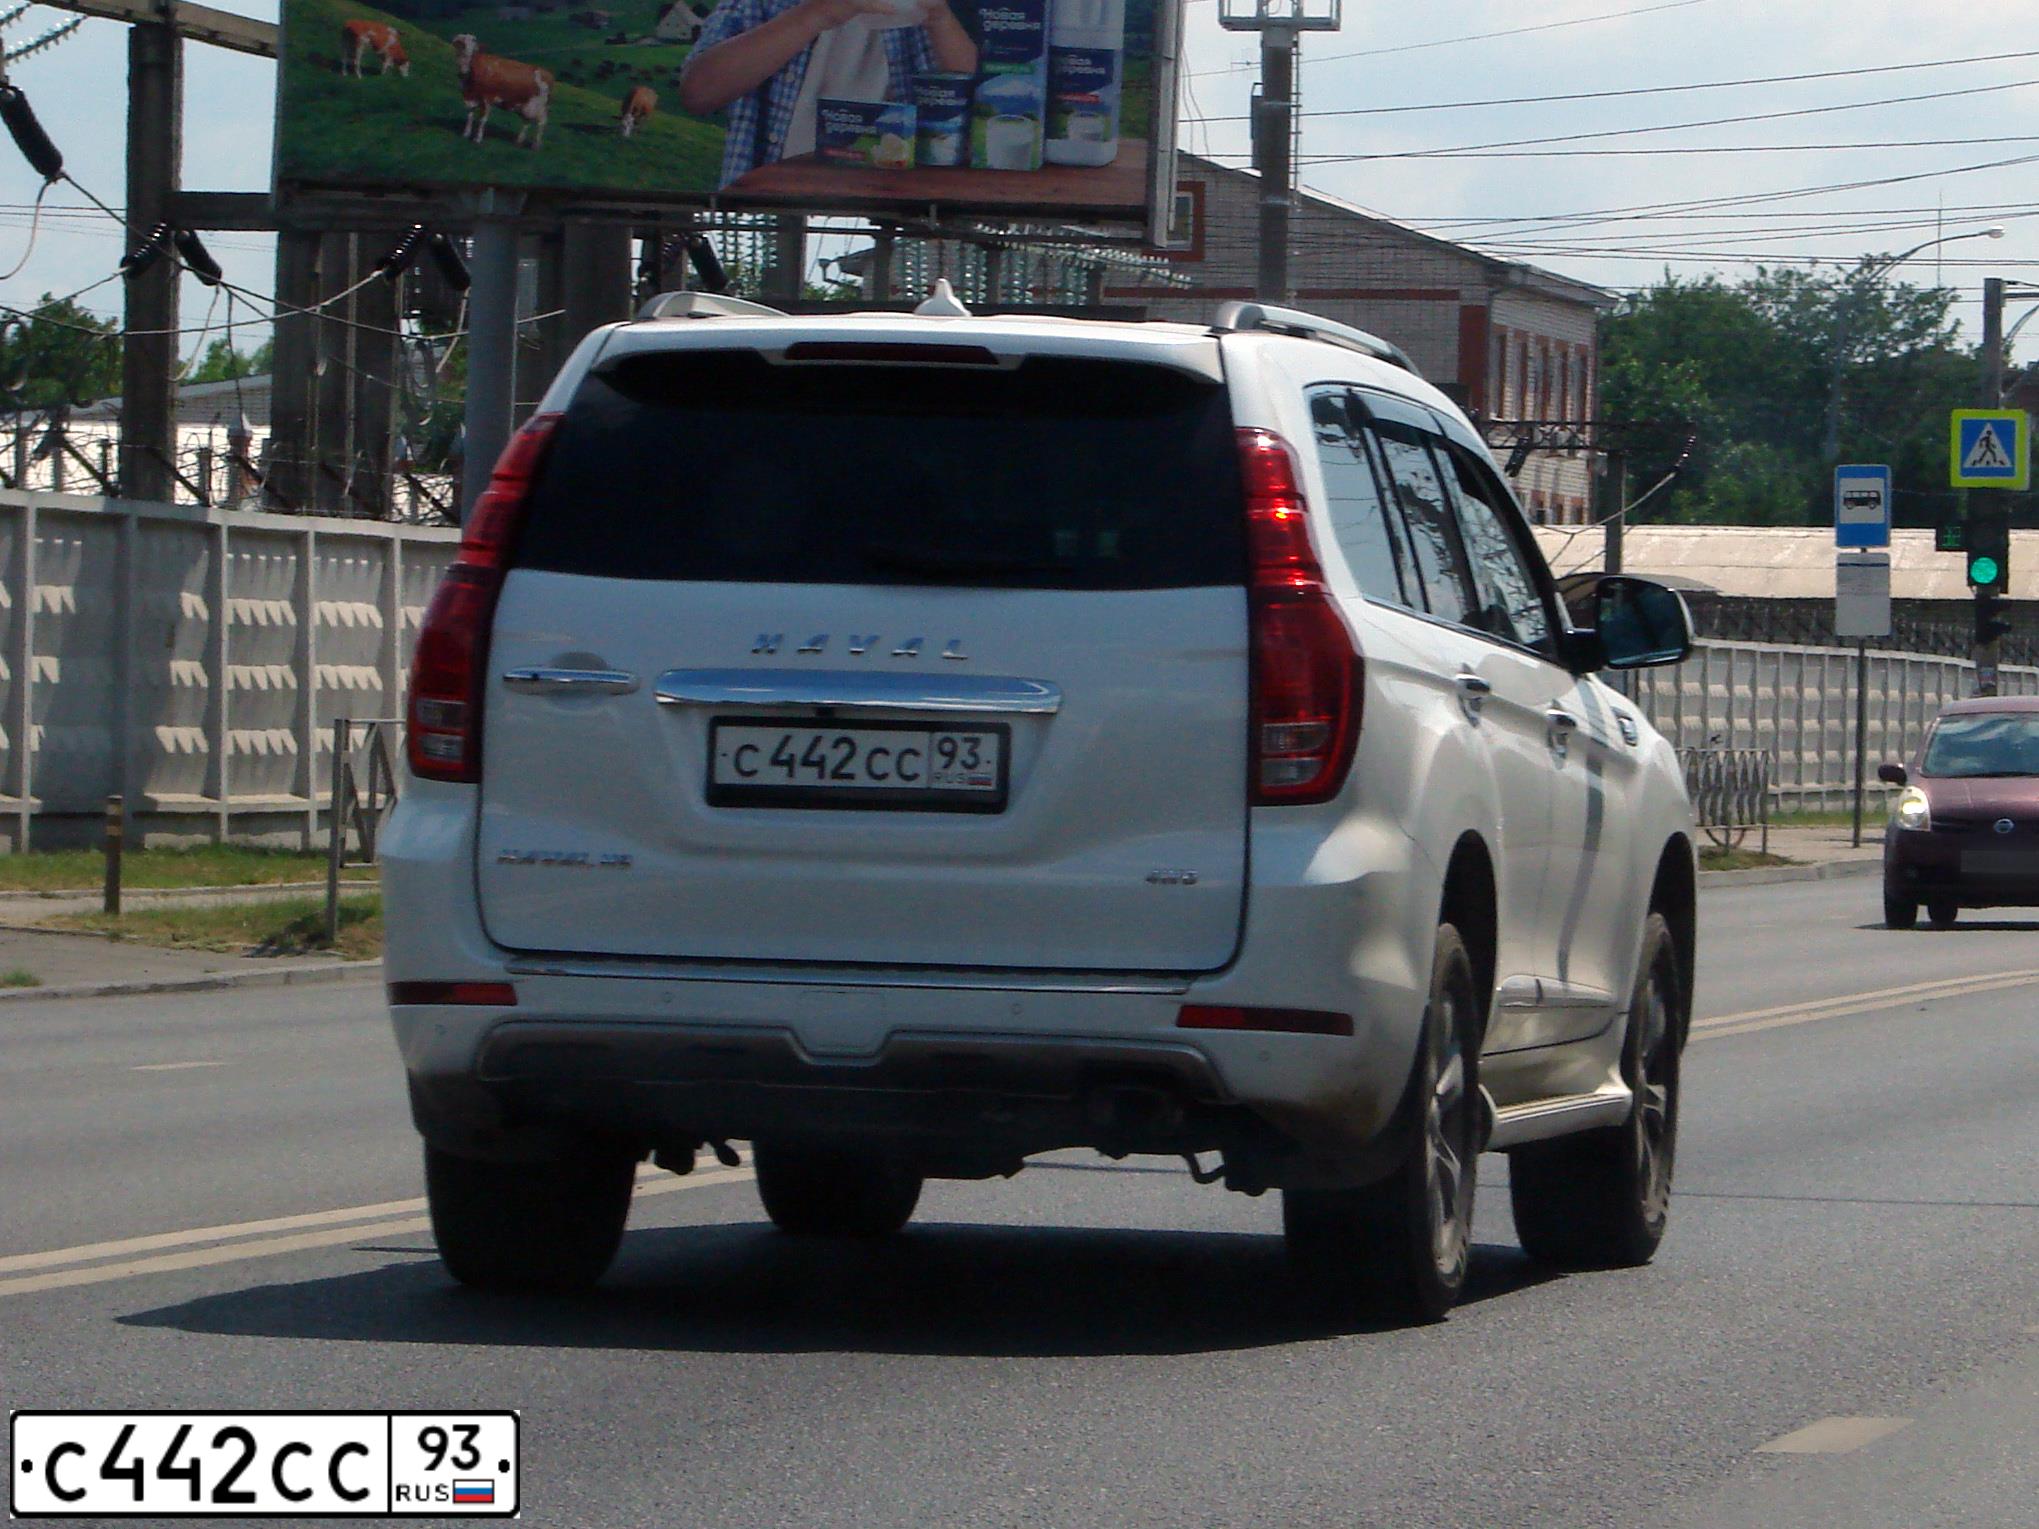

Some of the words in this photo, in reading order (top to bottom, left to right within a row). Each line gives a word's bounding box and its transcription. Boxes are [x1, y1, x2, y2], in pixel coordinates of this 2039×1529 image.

[752, 634, 968, 660] HAVAL
[733, 735, 921, 781] С442СС
[937, 736, 981, 769] 93
